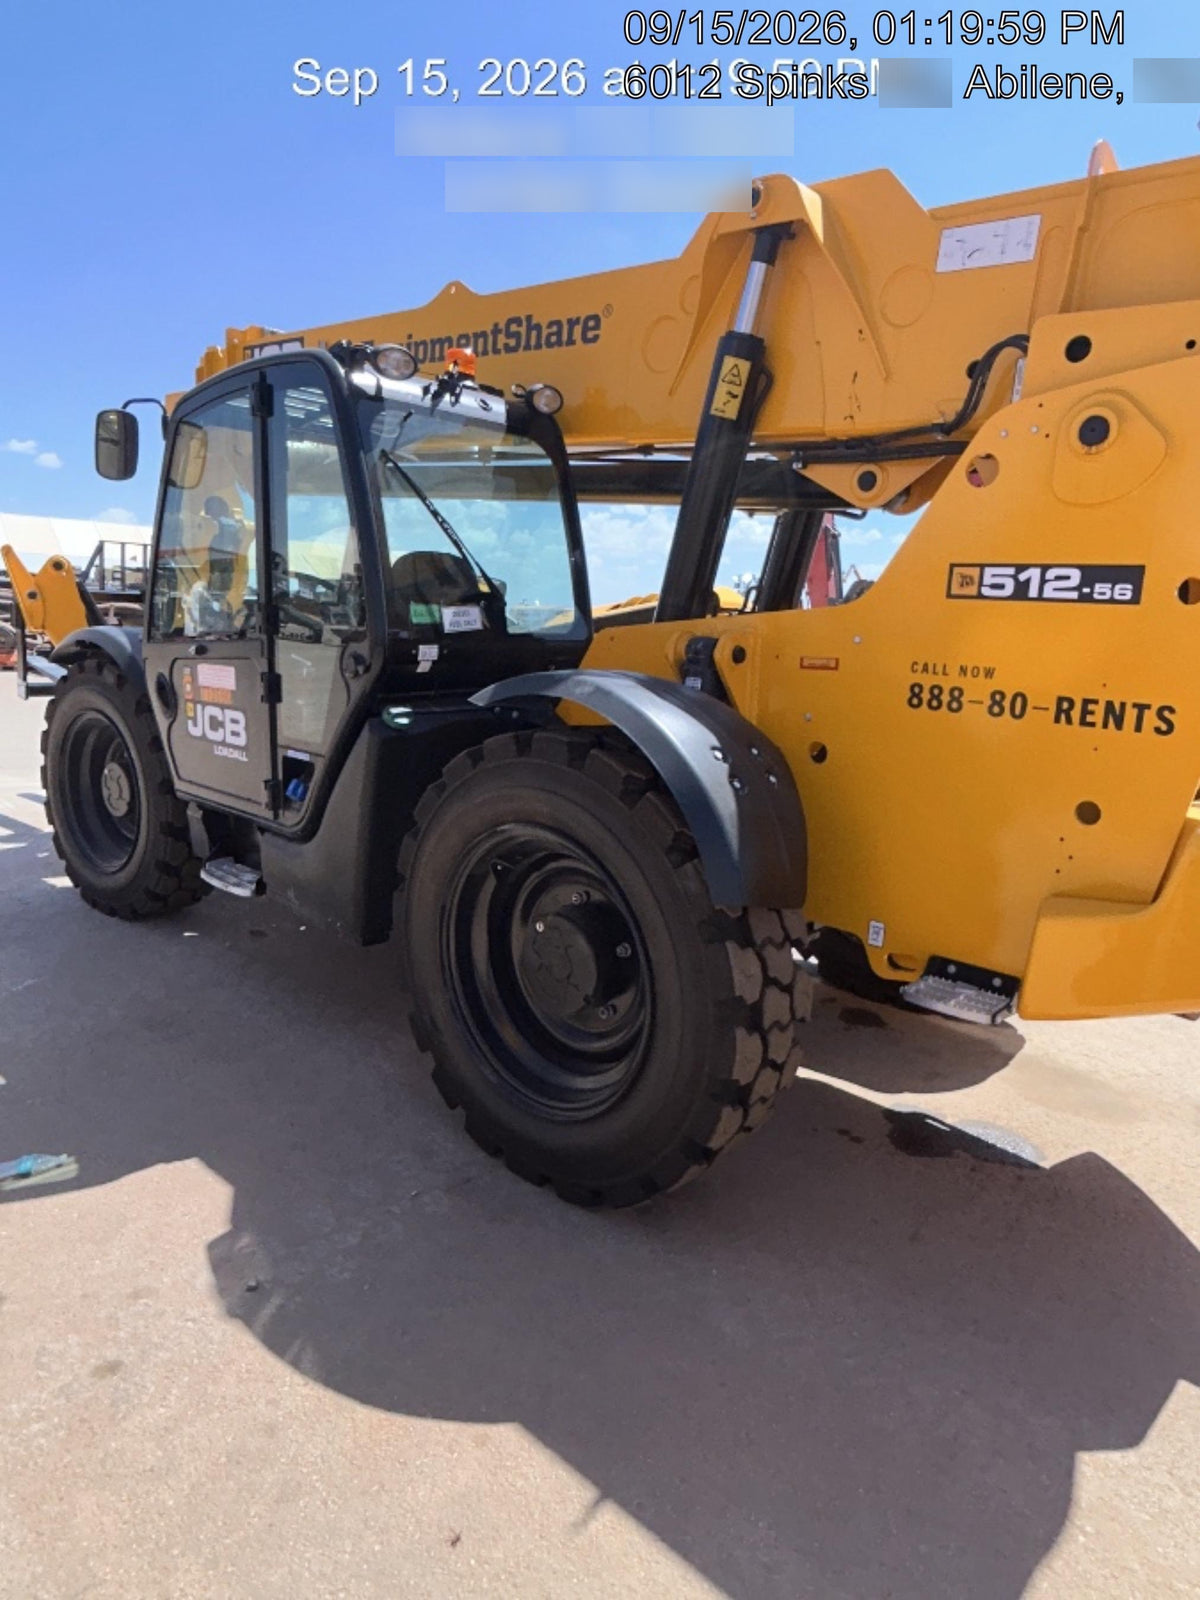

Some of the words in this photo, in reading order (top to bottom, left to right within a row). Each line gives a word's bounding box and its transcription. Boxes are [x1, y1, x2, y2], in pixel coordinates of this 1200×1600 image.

[366, 312, 602, 365] ipmentShare
[981, 566, 1133, 600] 512-56
[909, 660, 950, 677] CALL
[958, 663, 997, 680] NOW
[187, 702, 248, 747] JCB
